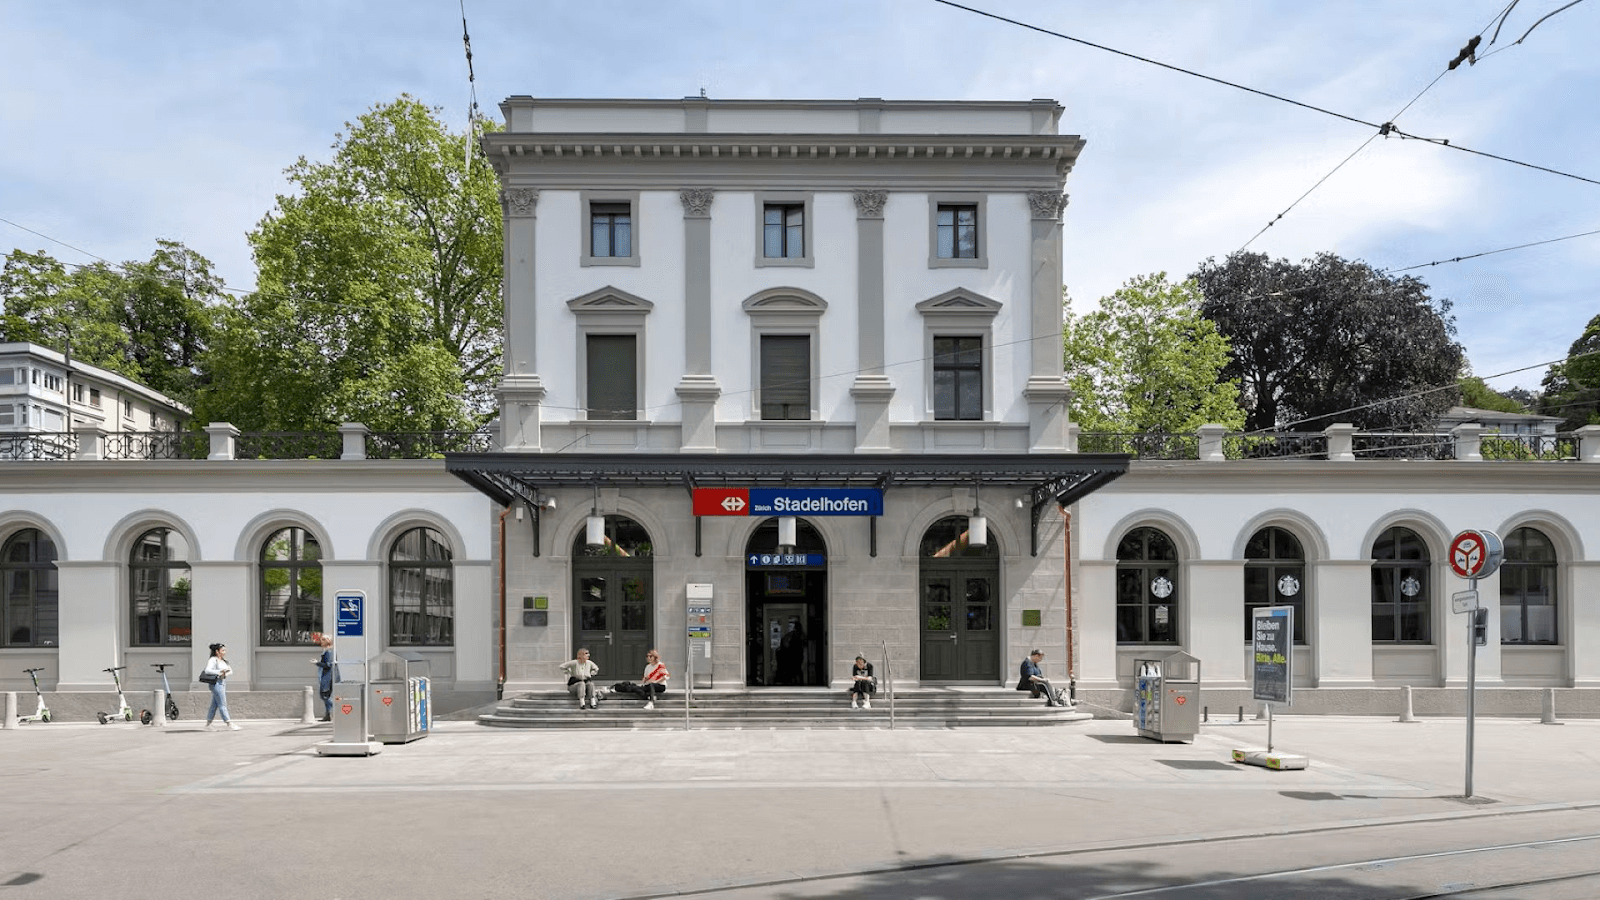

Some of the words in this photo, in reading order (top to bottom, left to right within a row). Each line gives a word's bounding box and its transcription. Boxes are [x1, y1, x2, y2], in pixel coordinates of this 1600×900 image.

[774, 497, 868, 511] Stadelhofen
[1256, 620, 1280, 631] Bleiben
[1256, 631, 1267, 641] Sie
[1267, 633, 1274, 641] zu
[1256, 641, 1277, 652] Hause.
